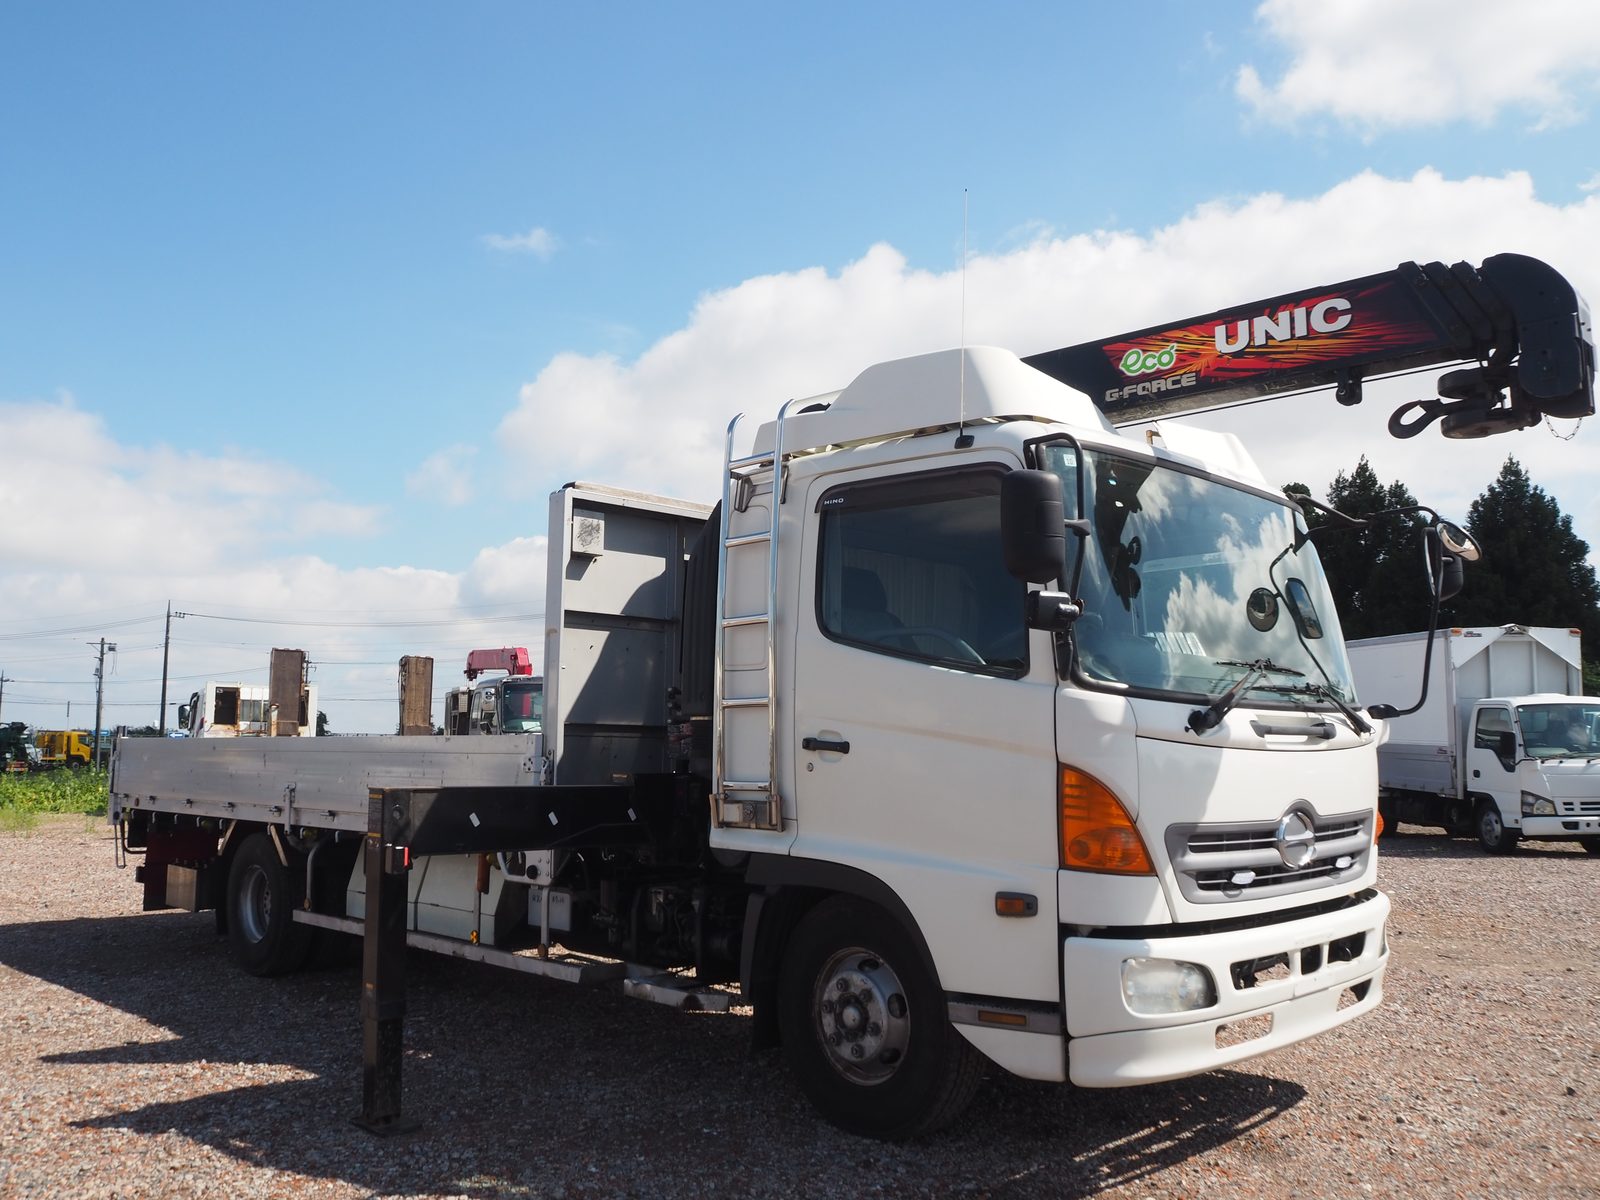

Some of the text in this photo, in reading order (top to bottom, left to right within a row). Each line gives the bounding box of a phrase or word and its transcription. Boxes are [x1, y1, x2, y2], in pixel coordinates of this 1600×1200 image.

[1214, 298, 1352, 354] UNIC
[1120, 344, 1176, 375] eco
[824, 497, 844, 506] HINO
